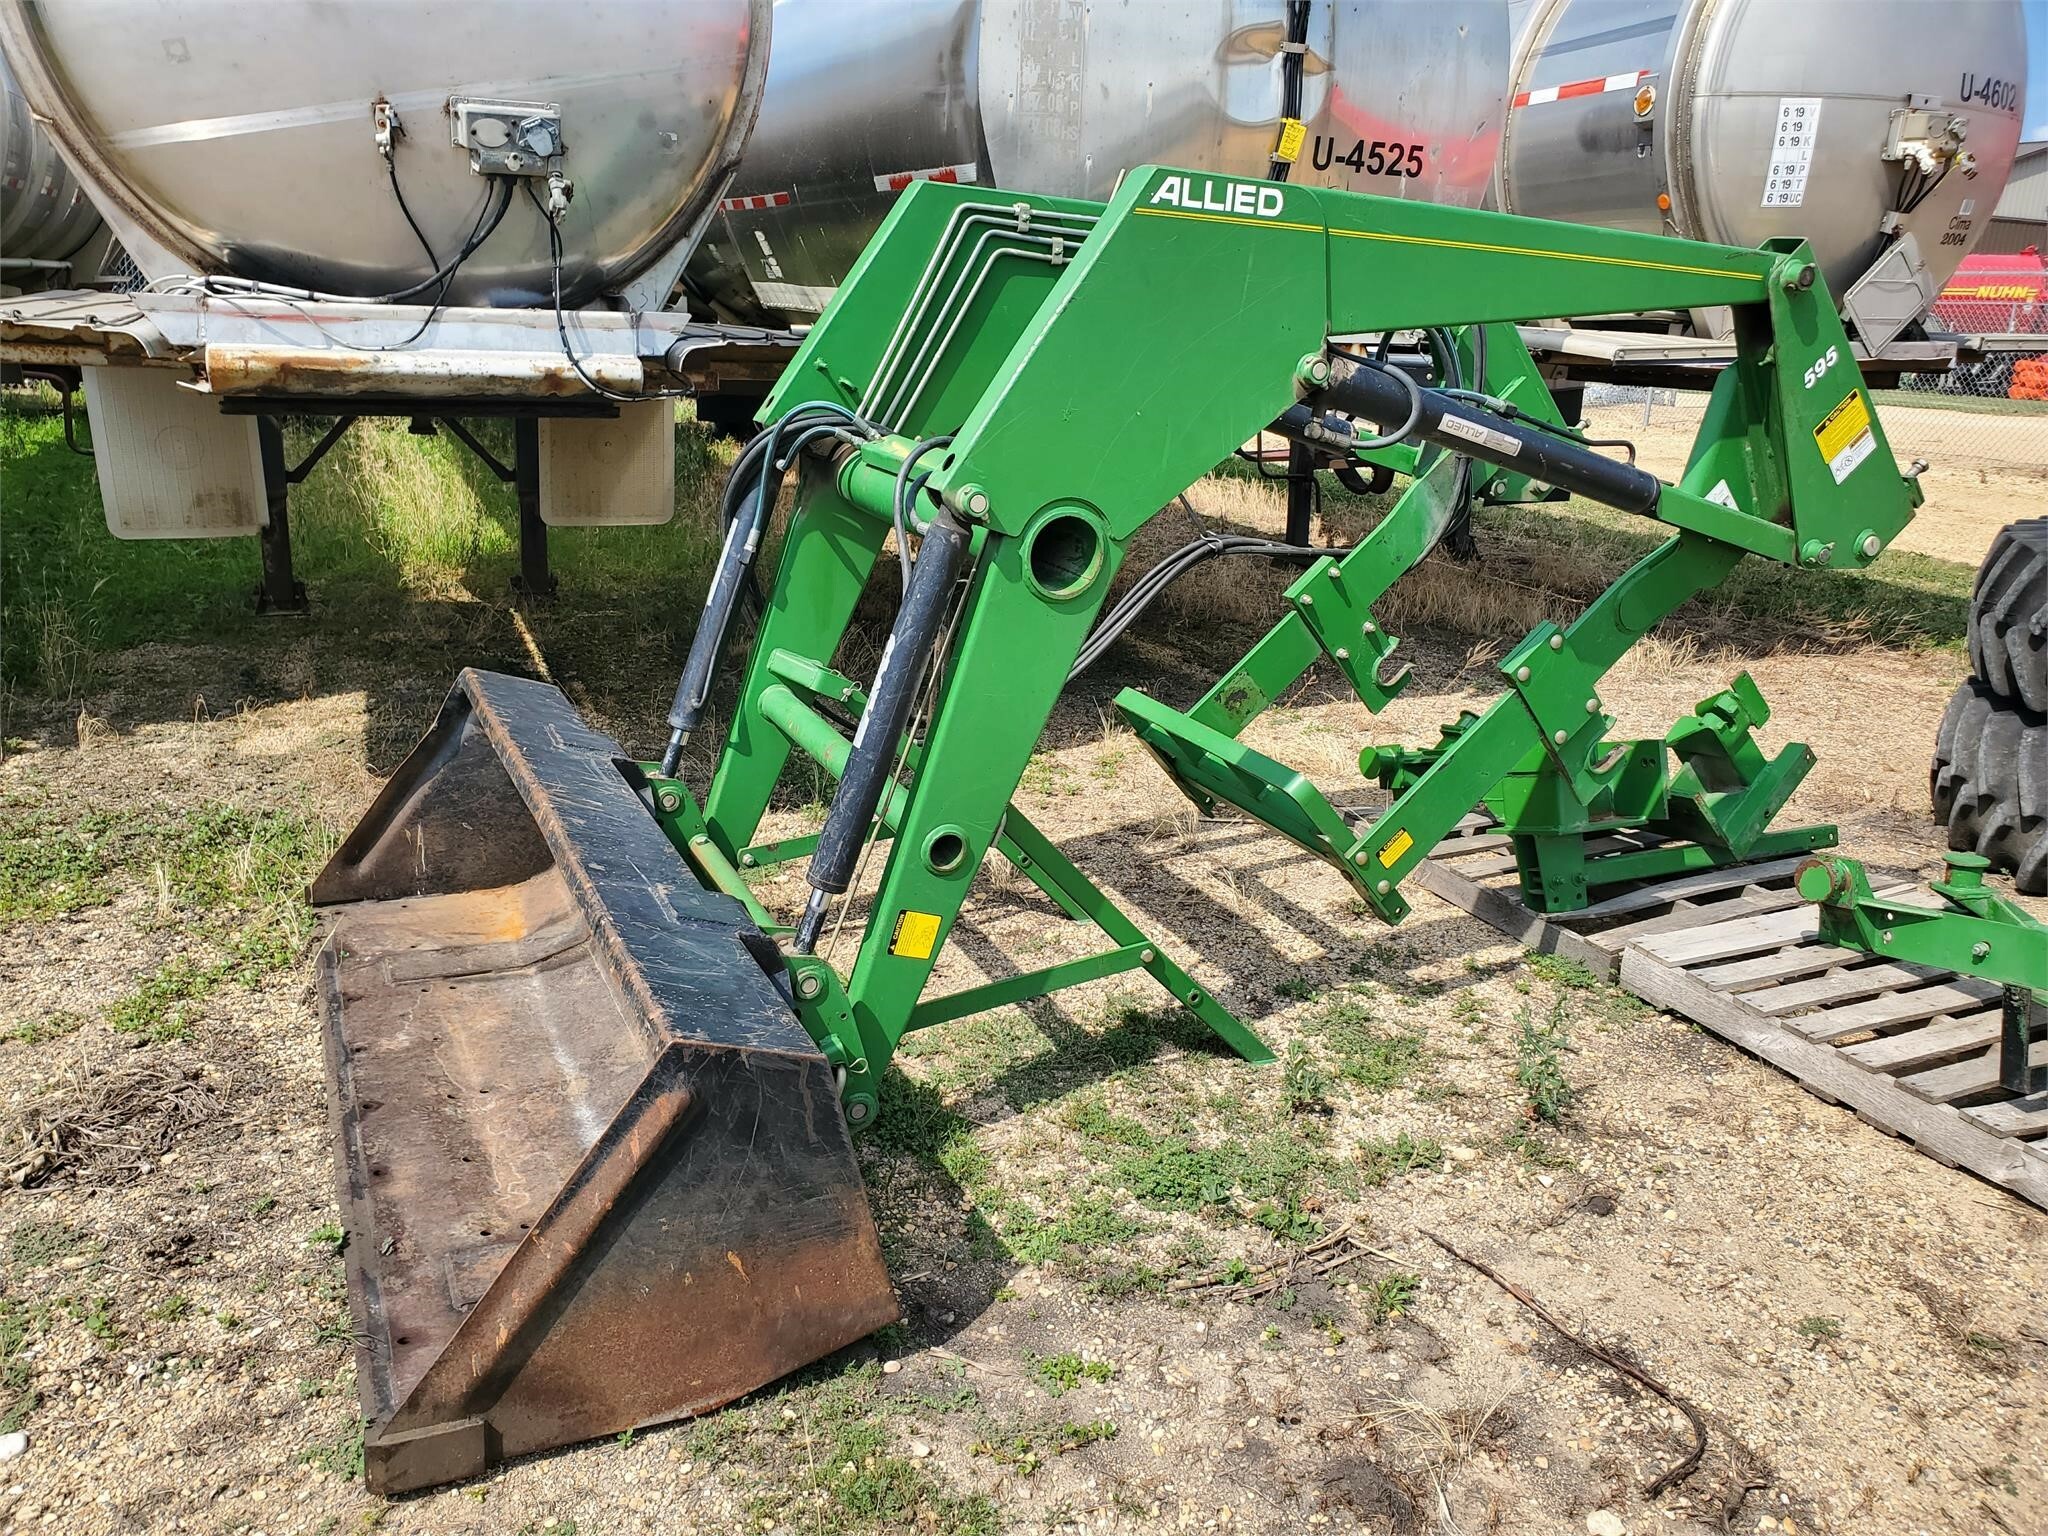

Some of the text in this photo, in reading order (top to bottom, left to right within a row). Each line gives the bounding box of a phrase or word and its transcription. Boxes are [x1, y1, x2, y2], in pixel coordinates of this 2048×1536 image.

[1959, 72, 2017, 112] U-4602
[1783, 107, 1790, 118] 6
[1795, 107, 1805, 118] 19
[1781, 121, 1788, 132] 6
[1792, 121, 1803, 132] 19
[1778, 136, 1785, 147] 6
[1790, 136, 1800, 147] 19
[1312, 135, 1424, 178] U-4525
[1773, 165, 1780, 175] 6
[1784, 165, 1795, 175] 19
[1770, 179, 1777, 190] 6
[1781, 179, 1791, 190] 19
[1150, 176, 1284, 217] ALLIED
[1767, 193, 1774, 203] 6
[1778, 193, 1788, 203] 19
[1940, 232, 1967, 246] 2004
[1975, 285, 2029, 299] NUHN
[1804, 345, 1838, 389] 595
[1446, 419, 1484, 438] ALLIED
[1383, 829, 1404, 850] CAUTION
[892, 914, 905, 940] CAUTION
